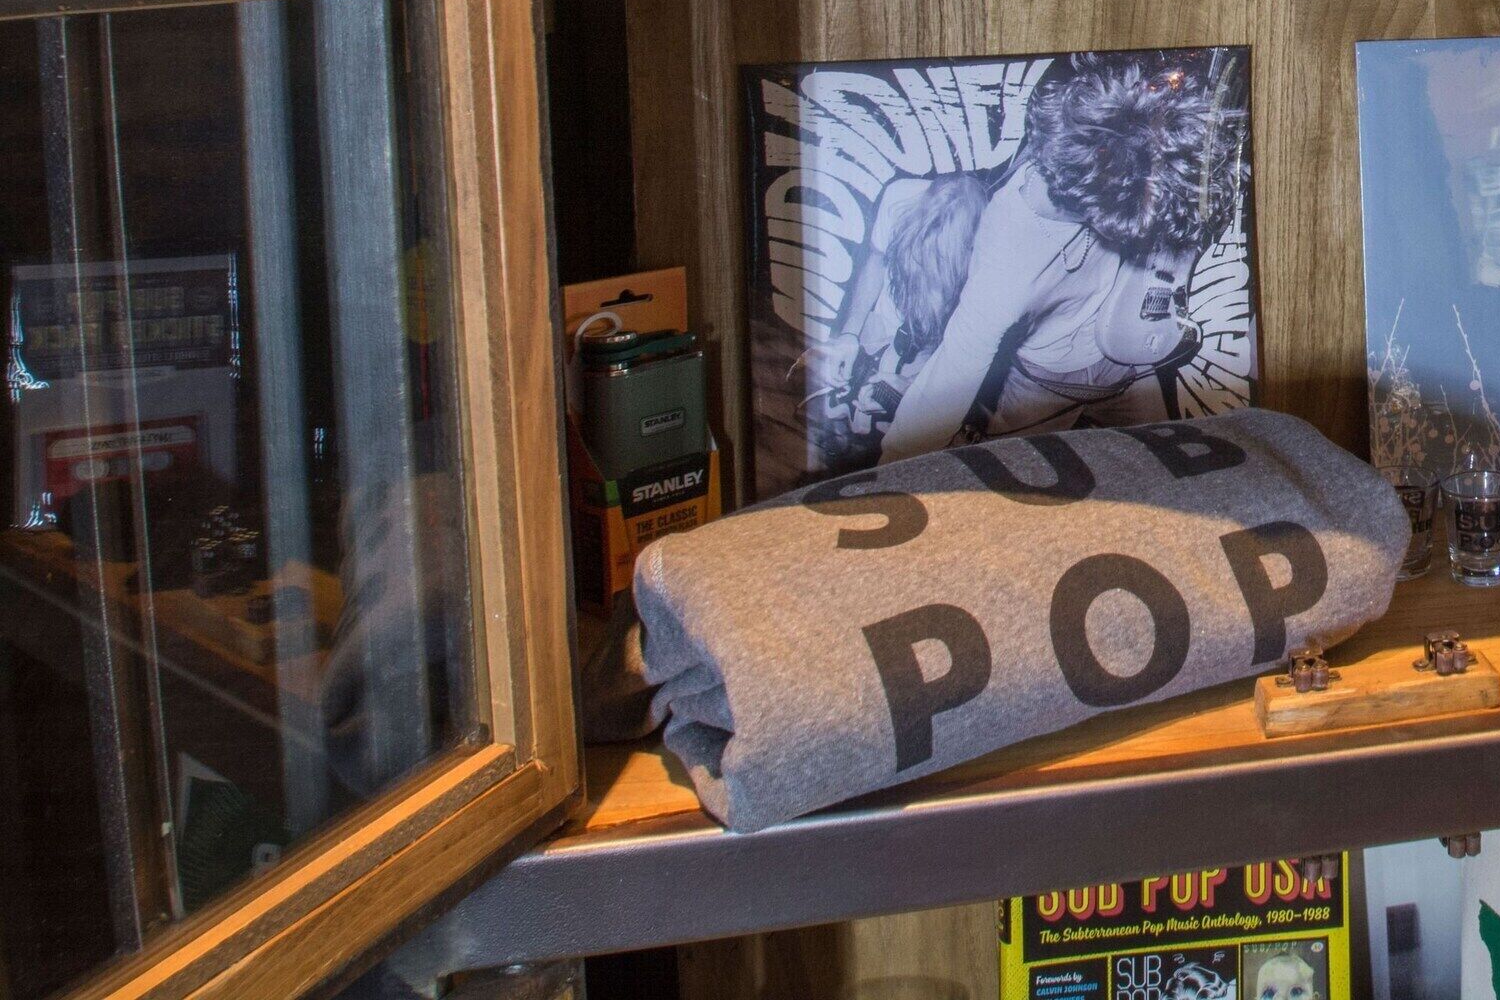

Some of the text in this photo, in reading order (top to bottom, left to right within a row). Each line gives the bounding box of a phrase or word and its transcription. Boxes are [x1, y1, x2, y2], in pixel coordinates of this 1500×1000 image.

[643, 410, 683, 428] STANLEY
[632, 468, 704, 503] STANLEY
[800, 422, 1247, 549] SUB
[657, 505, 698, 528] CLASSIC
[862, 520, 1329, 774] POP
[1039, 906, 1330, 944] The Subterranean Pop Music Anthology, 1980-1988
[1036, 971, 1082, 985] Forewords by
[1116, 954, 1162, 990] SUB
[1036, 983, 1099, 997] CALVIN JOHNSON
